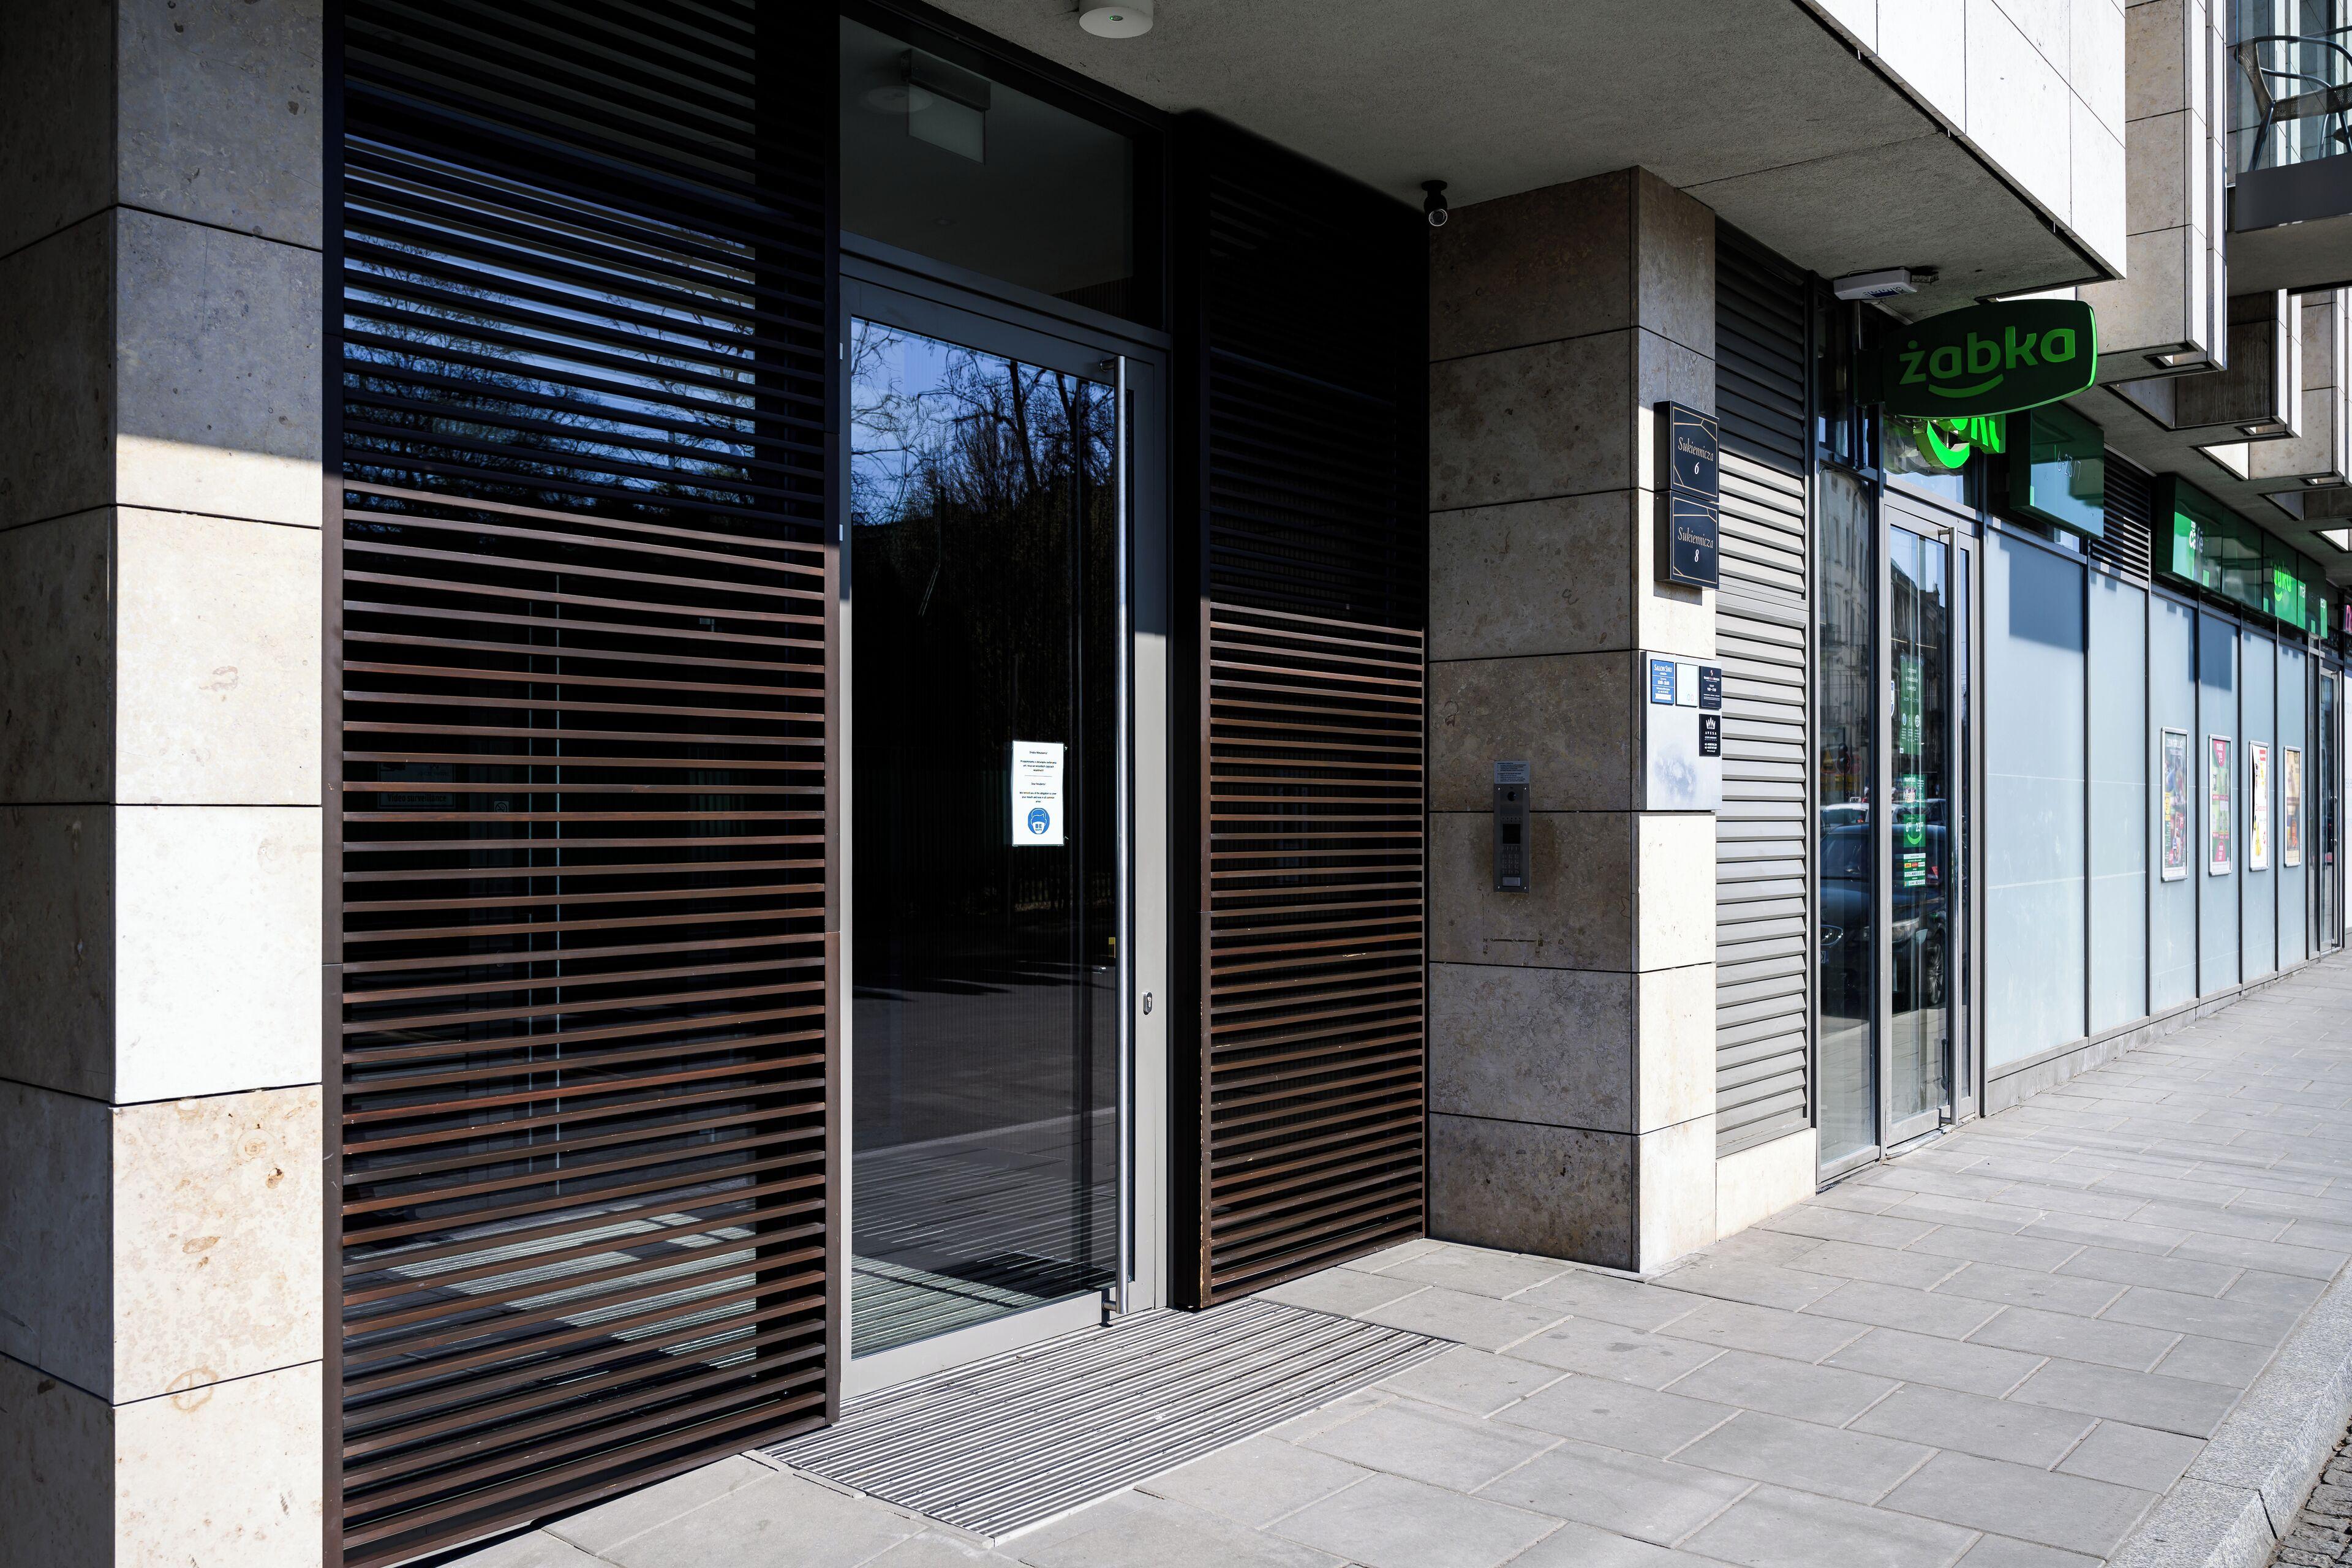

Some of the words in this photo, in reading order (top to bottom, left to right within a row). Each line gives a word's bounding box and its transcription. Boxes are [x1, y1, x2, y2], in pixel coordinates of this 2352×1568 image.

[1899, 326, 2076, 385] żabka
[1678, 437, 1714, 461] Sukiennicza
[1694, 462, 1700, 475] 6
[1678, 527, 1714, 549] Sukiennicza
[1694, 549, 1699, 563] 8
[388, 793, 405, 802] Video
